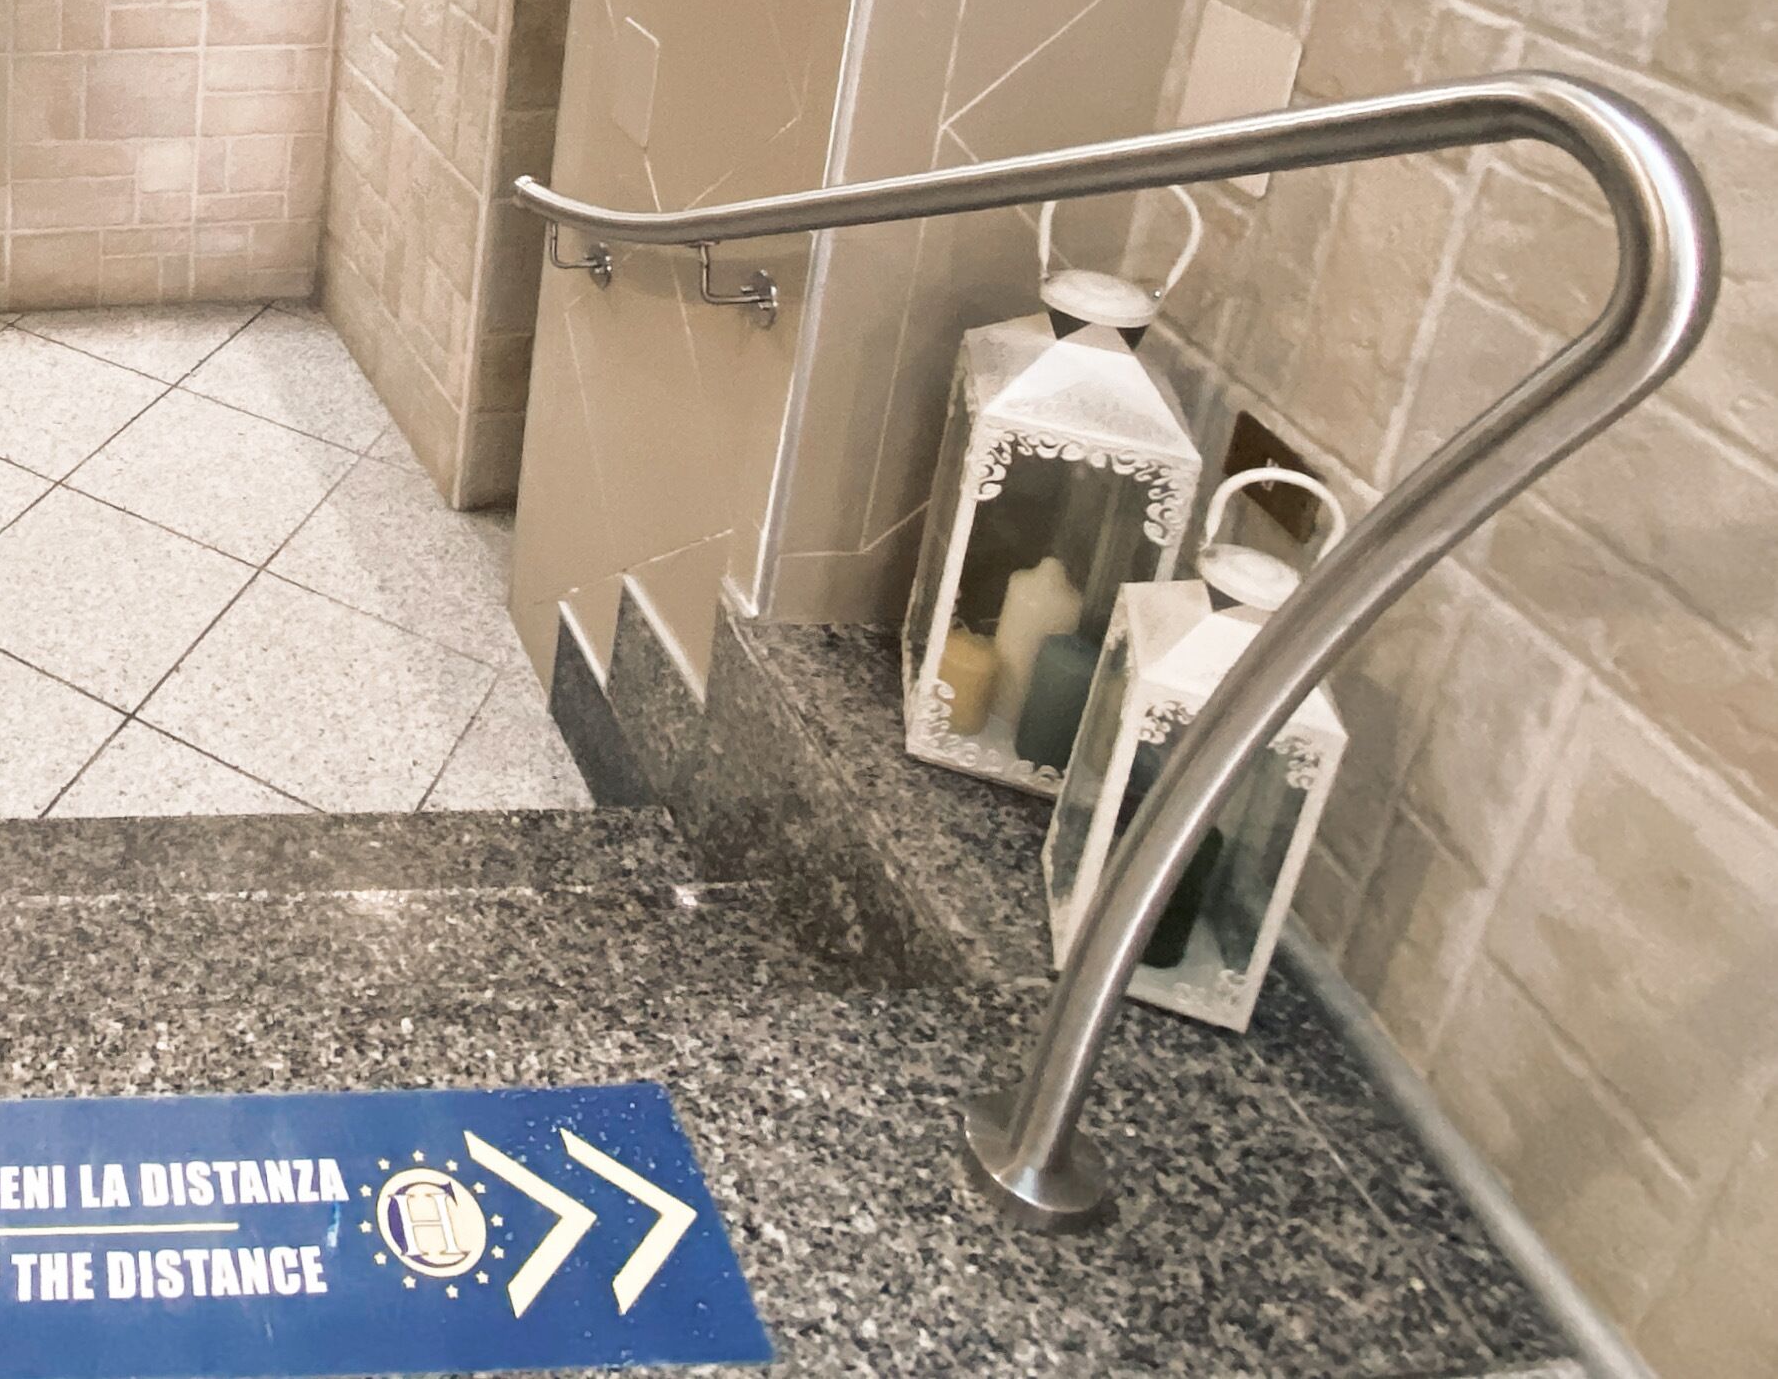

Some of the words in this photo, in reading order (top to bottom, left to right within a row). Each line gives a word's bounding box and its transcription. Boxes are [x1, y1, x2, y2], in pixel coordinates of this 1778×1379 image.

[79, 1163, 131, 1209] LA
[140, 1158, 350, 1207] DISTANZA
[10, 1251, 95, 1303] THE
[106, 1245, 328, 1300] DISTANCE
